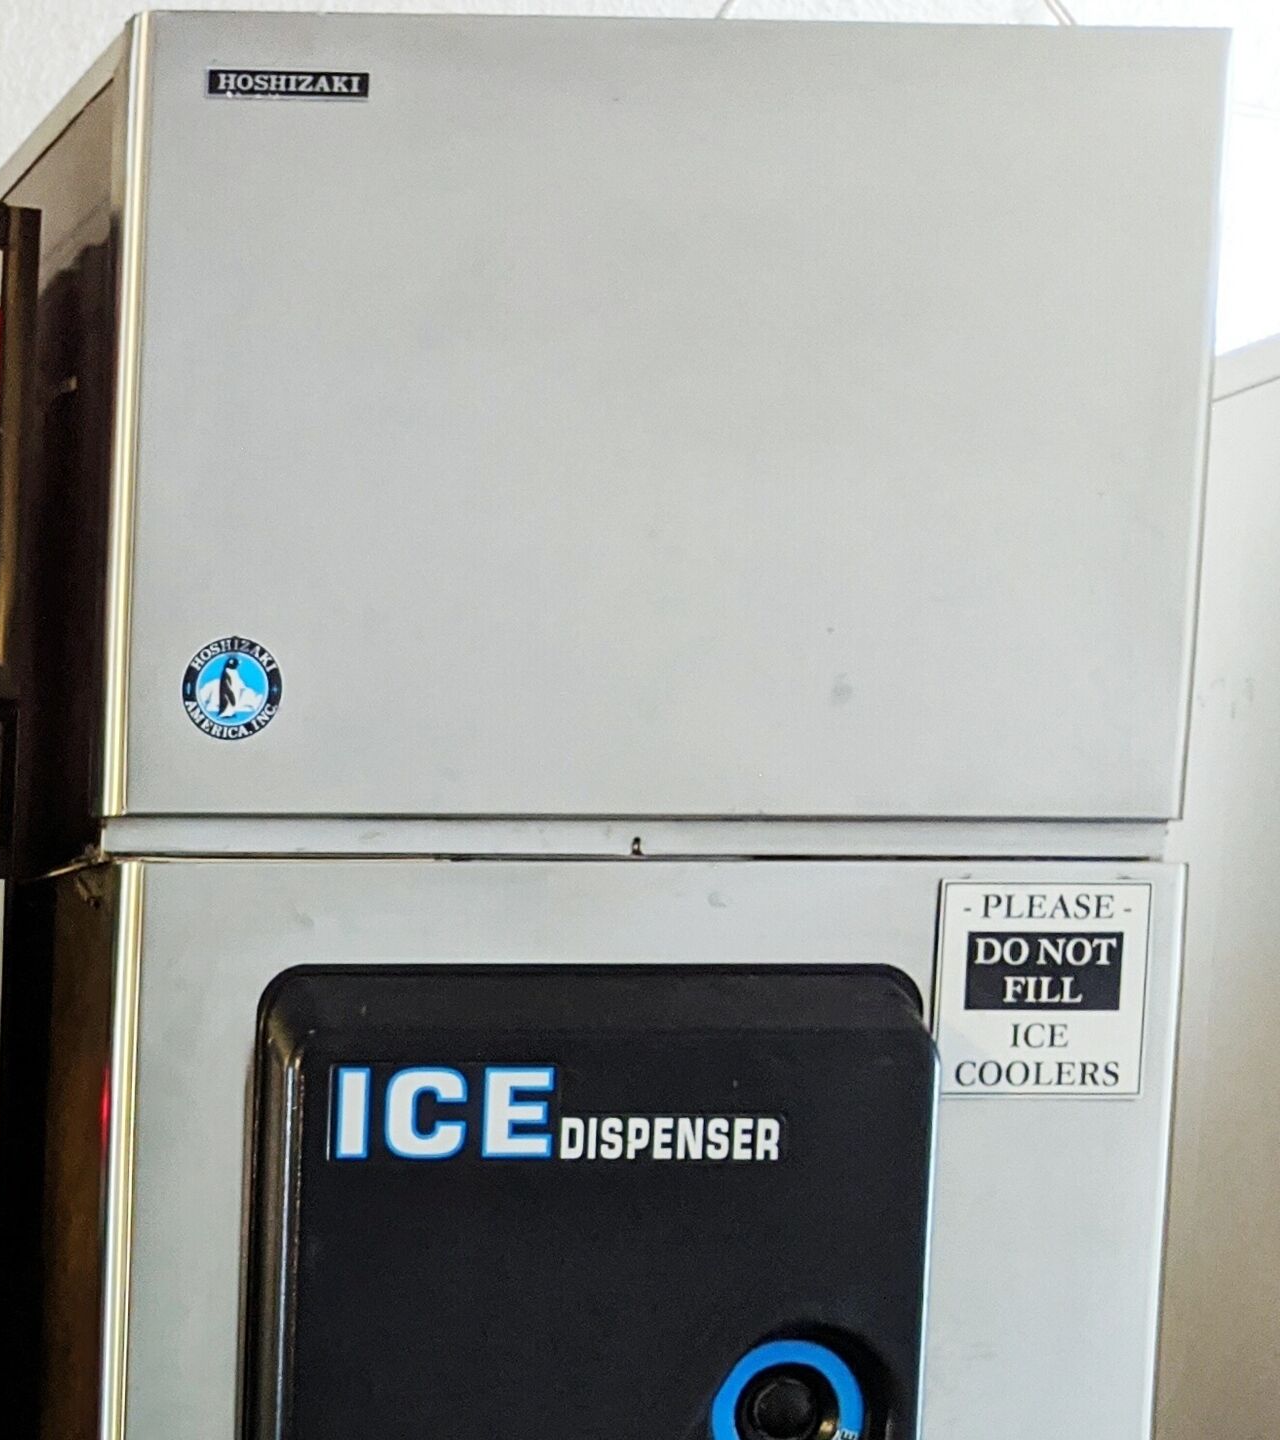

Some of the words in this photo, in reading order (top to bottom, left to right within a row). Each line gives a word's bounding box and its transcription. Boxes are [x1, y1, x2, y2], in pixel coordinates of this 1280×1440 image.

[217, 73, 361, 93] HOSHIZAKI
[189, 639, 278, 673] HOSHIZAKI
[981, 893, 1115, 920] PLEASE
[974, 937, 1030, 966] DO
[1035, 937, 1118, 966] NOT
[1002, 975, 1083, 1003] FILL
[1009, 1023, 1068, 1049] ICE
[954, 1060, 1120, 1088] COOLERS
[335, 1067, 557, 1160] ICE
[559, 1116, 782, 1161] DISPENSER
